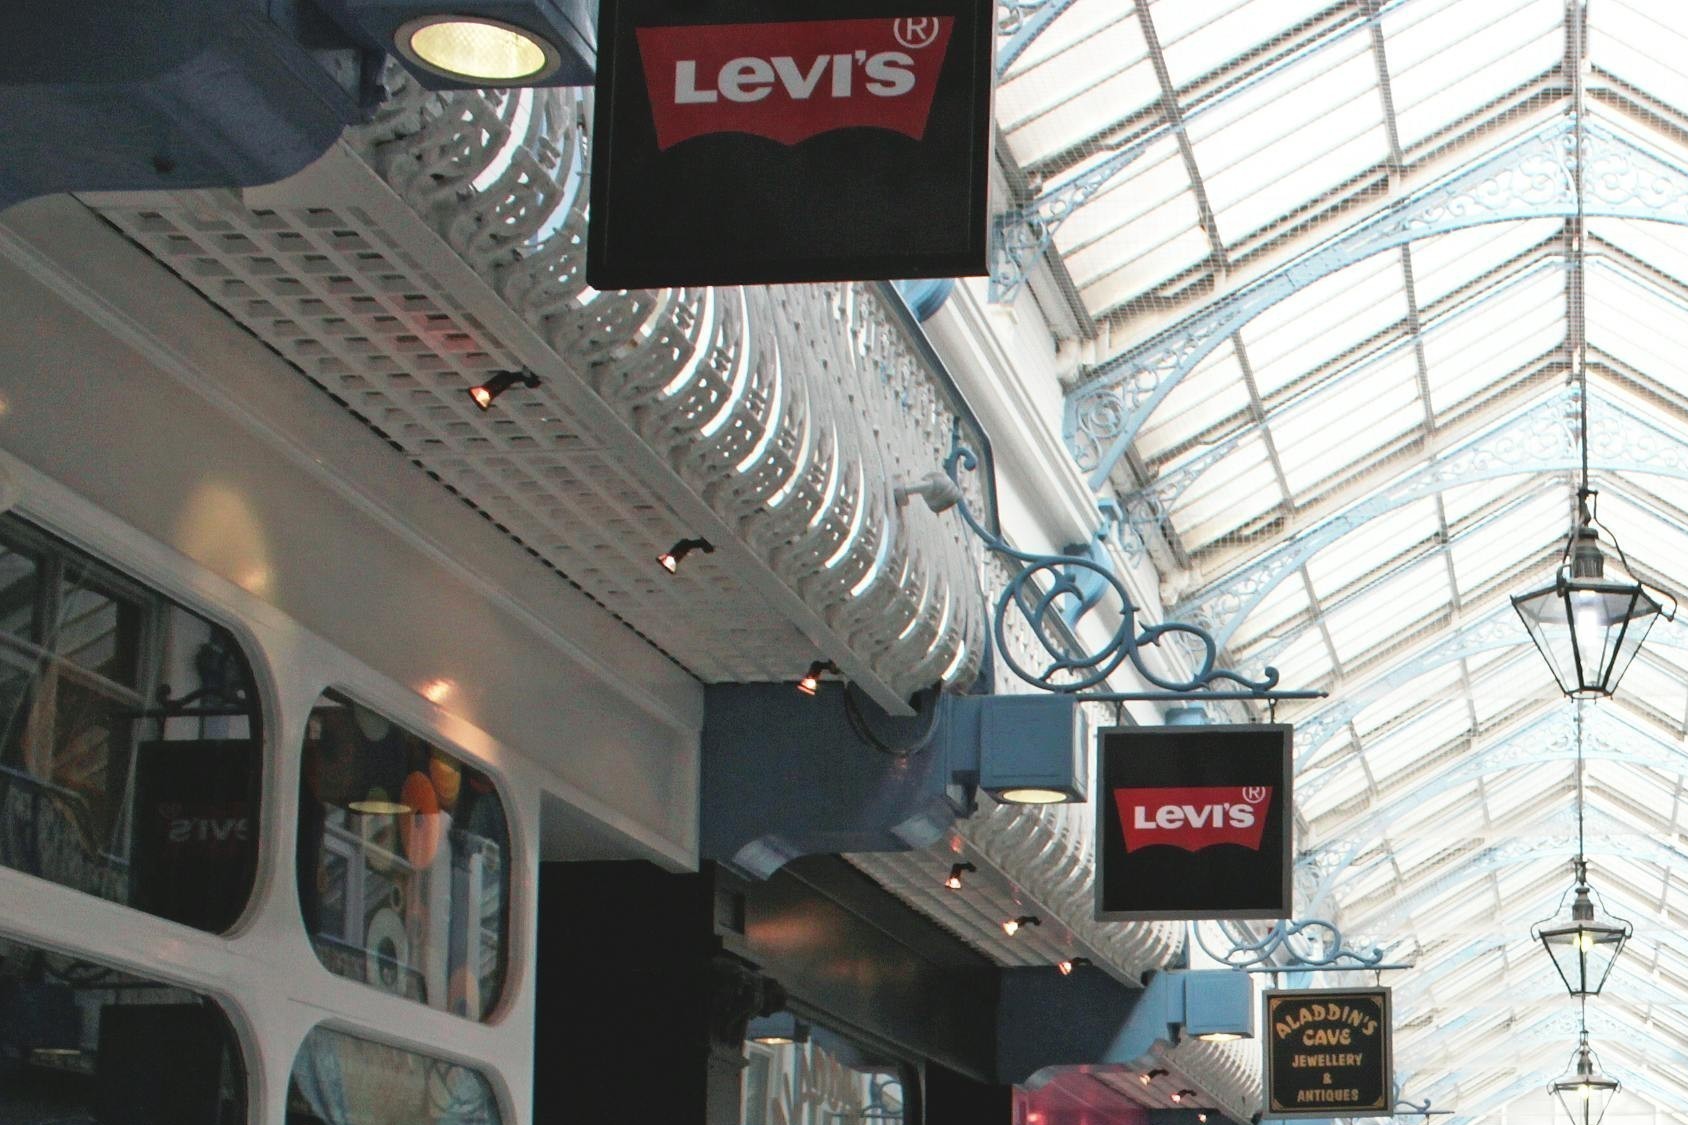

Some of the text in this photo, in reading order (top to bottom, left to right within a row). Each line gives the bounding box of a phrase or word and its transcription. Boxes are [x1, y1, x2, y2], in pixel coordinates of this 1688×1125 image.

[1275, 1003, 1378, 1040] ALADDIN'S
[1302, 1028, 1352, 1047] CAVE
[1291, 1052, 1363, 1069] JEWELLERY
[1322, 1072, 1333, 1084] &
[1296, 1088, 1360, 1103] ANTIQUES
